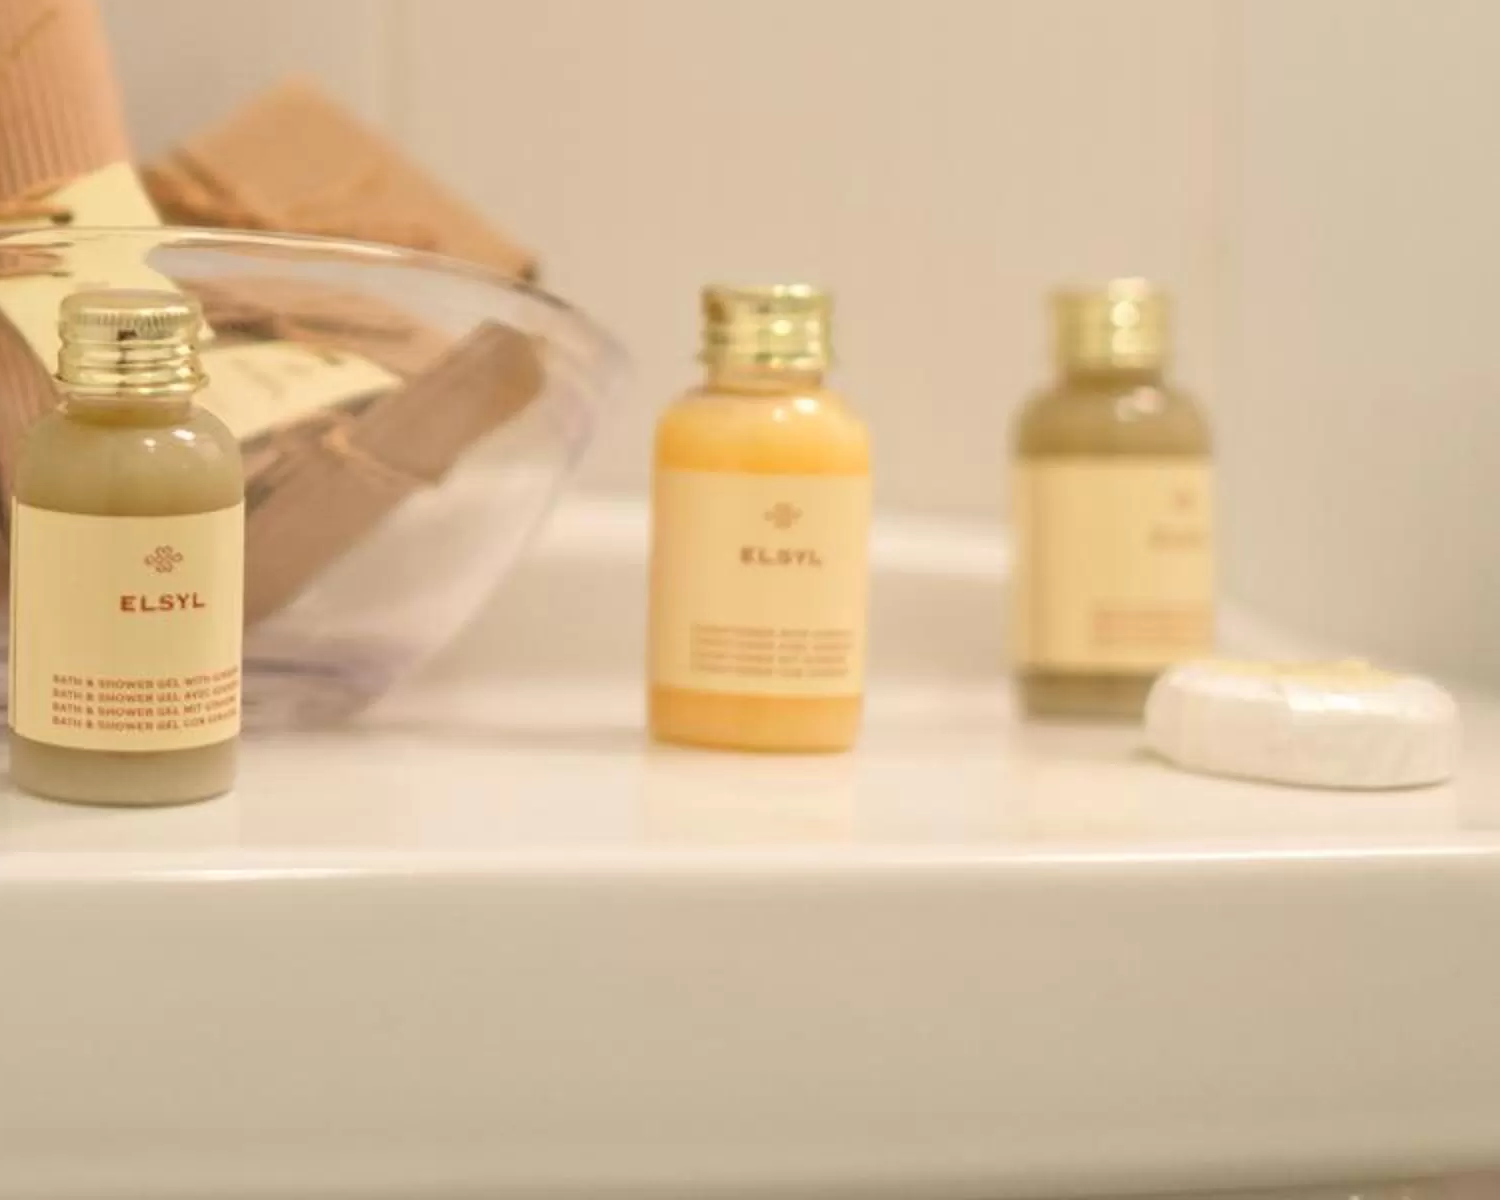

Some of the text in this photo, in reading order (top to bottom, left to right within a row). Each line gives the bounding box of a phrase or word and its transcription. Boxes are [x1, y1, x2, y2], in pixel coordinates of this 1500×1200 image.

[740, 546, 823, 566] ELSYL
[119, 592, 206, 612] ELSYL
[52, 673, 83, 686] BATH
[97, 678, 154, 689] SHOWER
[156, 678, 180, 689] GEL
[52, 688, 83, 700] BATH
[97, 692, 154, 704] SHOWER
[156, 692, 181, 703] GEL
[52, 702, 82, 714] BATH
[97, 706, 154, 718] SHOWER
[156, 706, 181, 717] GEL
[183, 703, 201, 715] MIT
[52, 715, 82, 728] BATH
[97, 720, 154, 732] SHOWER
[156, 720, 180, 731] GEL
